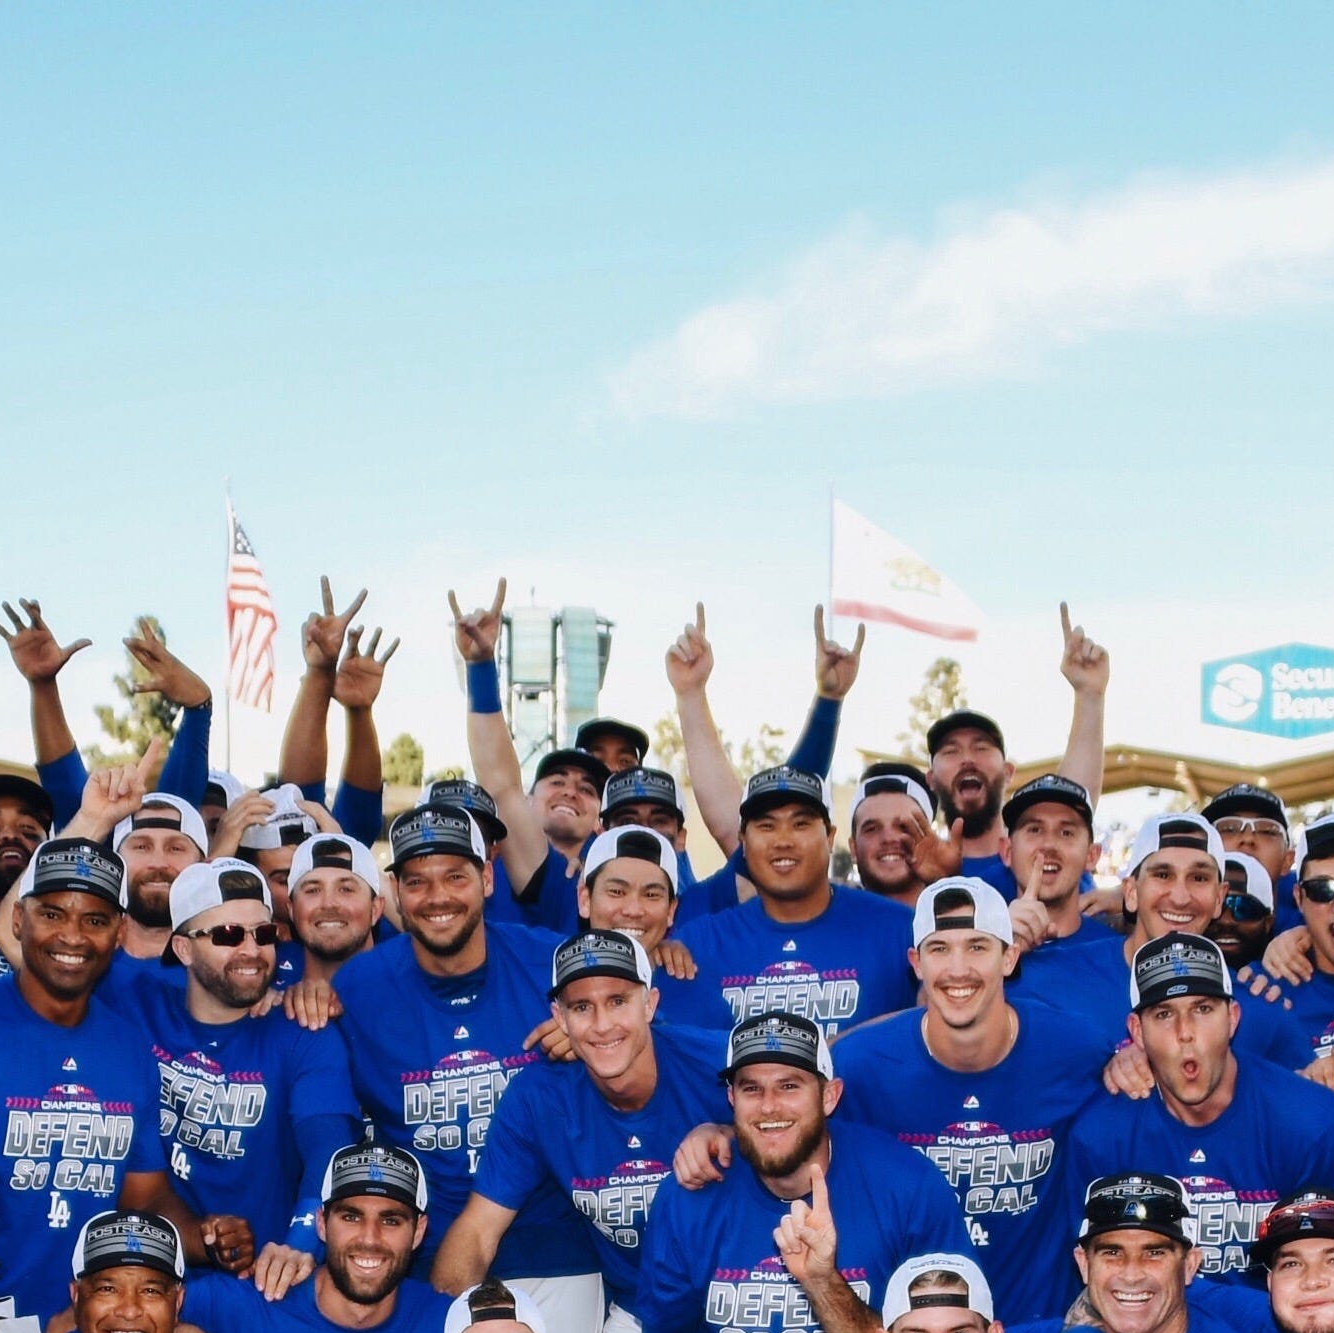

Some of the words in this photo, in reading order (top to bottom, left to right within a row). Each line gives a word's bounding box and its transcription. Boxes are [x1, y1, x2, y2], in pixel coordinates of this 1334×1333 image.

[755, 973, 820, 985] CHAMPIONS
[170, 1061, 227, 1084] CHAMPIONS
[431, 1061, 502, 1081] CHAMPIONS
[40, 1101, 103, 1113] CHAMPIONS
[159, 1062, 267, 1128] EFEND
[403, 1067, 526, 1125] DEFEN
[3, 1110, 134, 1161] DEFEND
[176, 1121, 246, 1159] CAL
[413, 1124, 462, 1152] SO
[937, 1134, 1011, 1147] CHAMPIONS
[171, 1142, 192, 1181] LA
[332, 1155, 419, 1178] POSTSEASON
[912, 1139, 1055, 1187] EFEND
[9, 1159, 50, 1191] SO
[53, 1159, 116, 1194] CAL
[608, 1170, 674, 1186] CHAMPION
[48, 1190, 71, 1229] LA
[965, 1185, 1038, 1215] CAL
[86, 1223, 175, 1247] POSTSEASON
